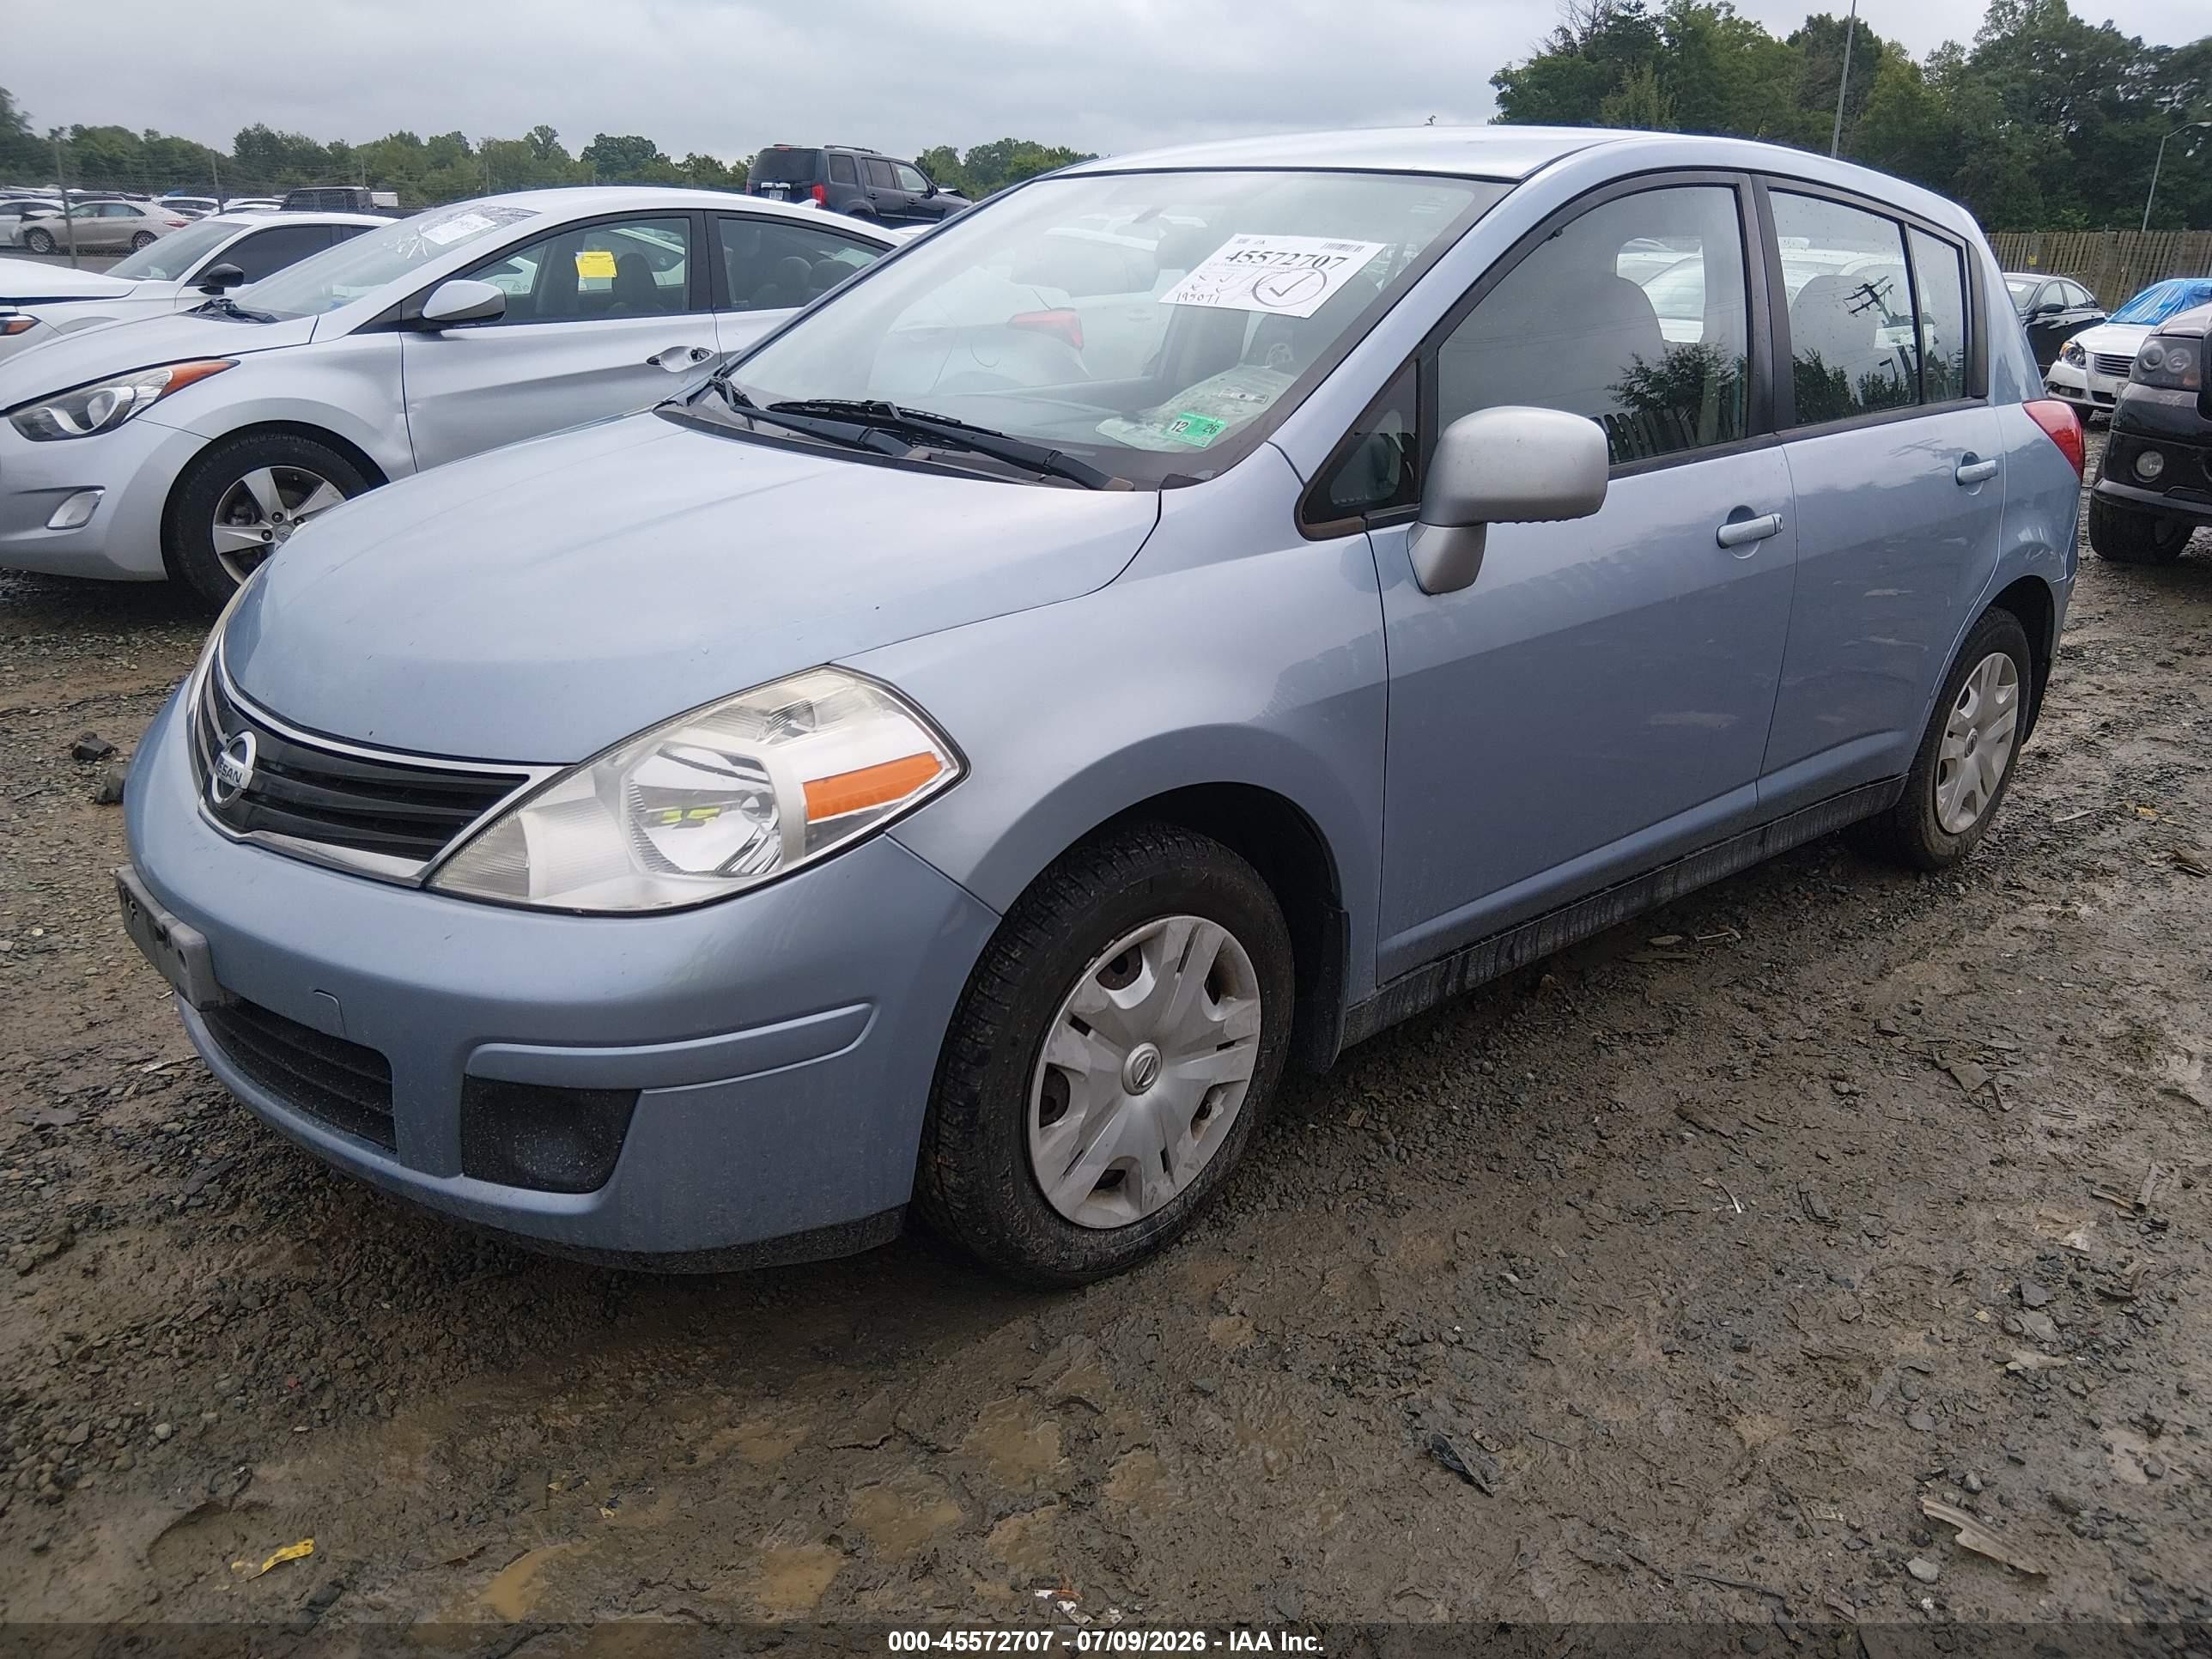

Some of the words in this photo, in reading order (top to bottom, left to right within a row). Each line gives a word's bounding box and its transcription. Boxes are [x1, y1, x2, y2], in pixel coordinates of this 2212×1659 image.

[1225, 250, 1349, 270] 45572707
[1171, 420, 1189, 433] 12
[1202, 423, 1219, 434] 26
